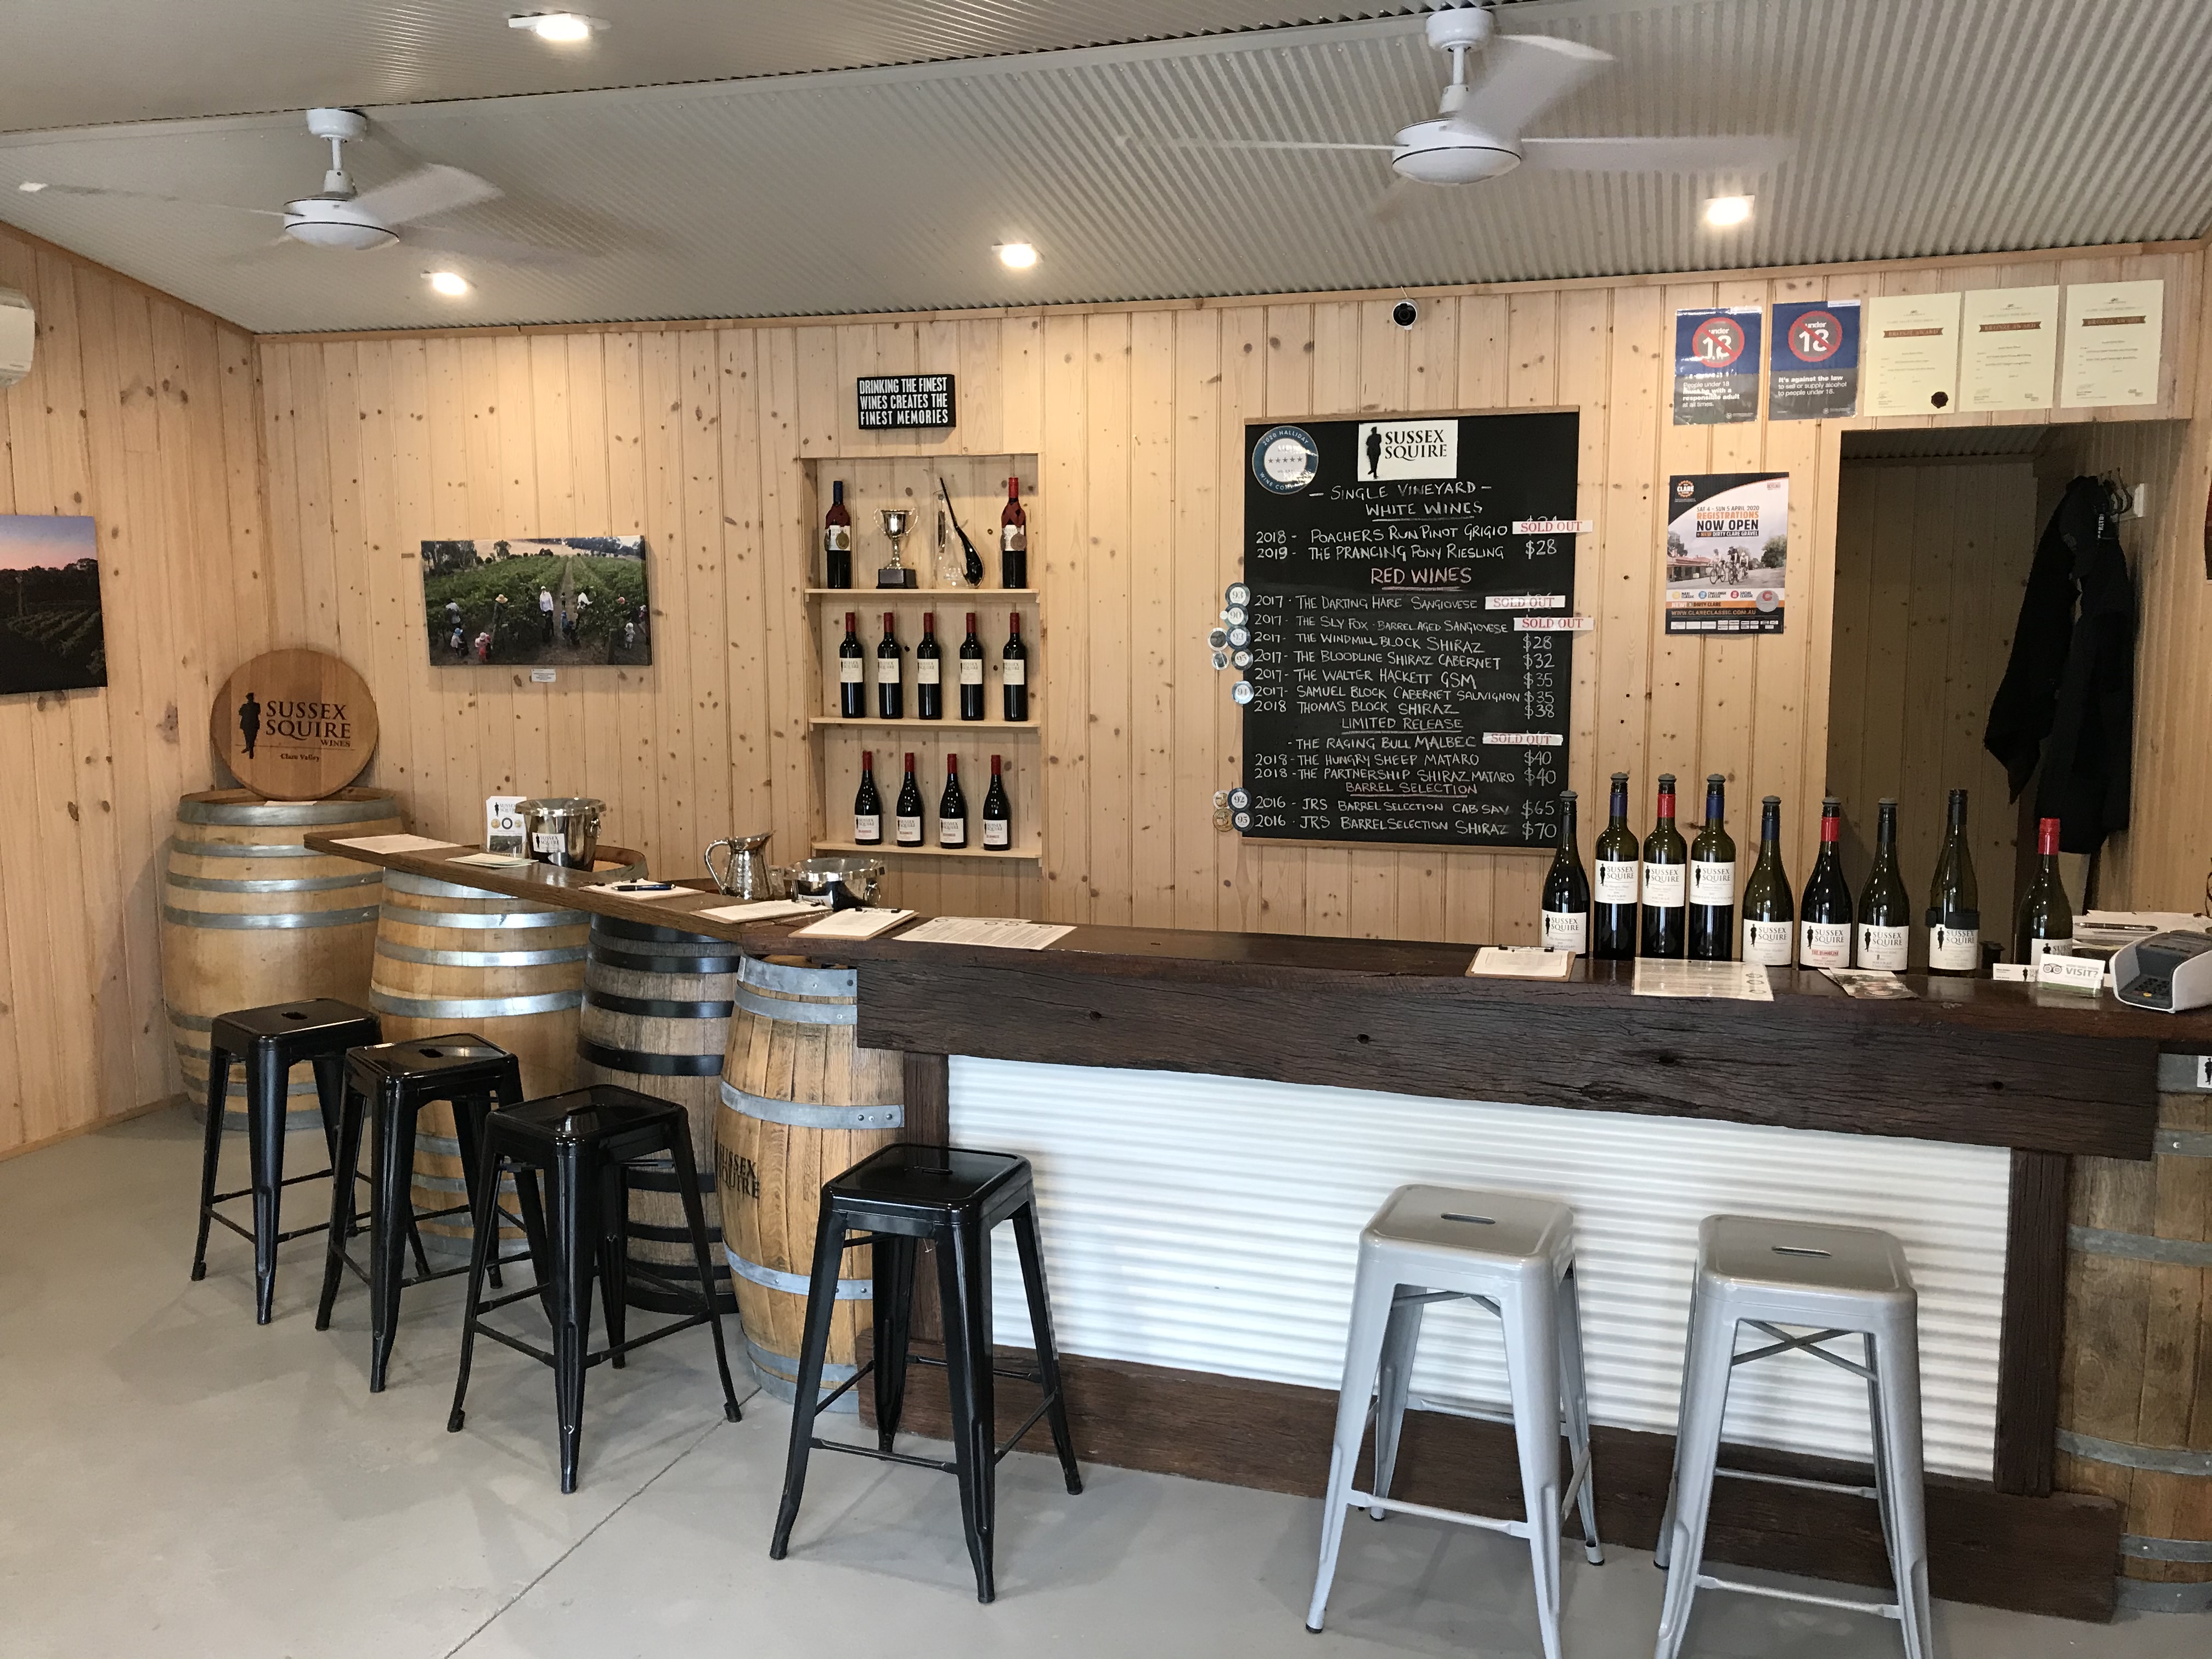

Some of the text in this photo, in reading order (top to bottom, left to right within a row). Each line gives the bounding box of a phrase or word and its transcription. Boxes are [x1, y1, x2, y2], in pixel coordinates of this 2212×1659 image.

[859, 377, 947, 394] DRINKING THE FINEST
[860, 393, 947, 410] WINES CREATES THE
[860, 409, 948, 425] FINEST MEMORIES
[1263, 430, 1309, 445] 2020 HALLIDAY
[1385, 430, 1444, 445] SUSSEX
[1385, 444, 1447, 461] SQUIRE
[1331, 482, 1476, 500] SINGLE VINEYARD
[1365, 501, 1482, 516] WHITE WINES
[1697, 511, 1759, 520] REGISTRATIONS
[1256, 523, 1508, 544] 2018 POACHERS RUN PINOT GRIGIO
[1521, 521, 1583, 532] SOLD OUT
[1697, 520, 1758, 531] NOW OPEN
[1257, 543, 1504, 562] 2019 THE PRANCING PONY RIESLING
[1525, 538, 1557, 559] $28
[1371, 567, 1472, 584] RED WINES
[1232, 591, 1244, 599] 93
[1254, 595, 1477, 611] 2017 THE DARTING HARE SANGIOVESE
[1254, 614, 1282, 626] 2017
[1296, 616, 1315, 626] THE
[1321, 616, 1344, 629] SLY
[1348, 618, 1368, 630] FOX
[1418, 621, 1441, 631] AGED
[1443, 620, 1509, 634] SANGIOVESE
[1522, 618, 1583, 628] SOLD OUT
[1254, 631, 1485, 653] 2017 THE WINDMILL BLOCK SHIRAZ
[1523, 633, 1552, 652] $28
[1254, 649, 1500, 669] 2017 THE BLOODLINE SHIRAZ CABERNET
[1523, 653, 1555, 669] $32
[1255, 668, 1476, 689] 2017 THE WALTER HACKETT GSM
[1523, 672, 1553, 689] $35
[1255, 685, 1520, 702] 2017 SAMUEL BLOCK CABERNET SAUVIGNON
[1524, 691, 1555, 704] $35
[266, 701, 347, 720] SUSSEX
[1254, 700, 1459, 715] 2018 THOMAS BLOCK SHIRAZ
[1525, 703, 1555, 719] $38
[266, 719, 351, 741] SQUIRE
[1342, 717, 1464, 730] LIMITED RELEASE
[1296, 735, 1476, 751] THE RAGING BULL MALBEC
[1491, 733, 1552, 745] SOLD OUT
[1255, 753, 1479, 767] 2018 THE HUNGRY SHEEP MATARO
[1524, 749, 1552, 766] $40
[1255, 768, 1515, 783] 2018 THE PARTNERSHIP SHIRAZ MATARO
[1523, 768, 1556, 786] $40
[1346, 782, 1477, 794] BARREL SELECTION
[1255, 795, 1509, 815] 2016 JRS BARREL SELECTION CAB SAV
[1521, 799, 1554, 819] $65
[1255, 814, 1509, 835] 2016 JRS BARREL SELECTION SHIRAZ
[1522, 821, 1557, 840] $70
[1702, 874, 1730, 883] SQUIRE
[1814, 935, 1844, 944] SQUIRE
[2066, 967, 2098, 978] VISIT?
